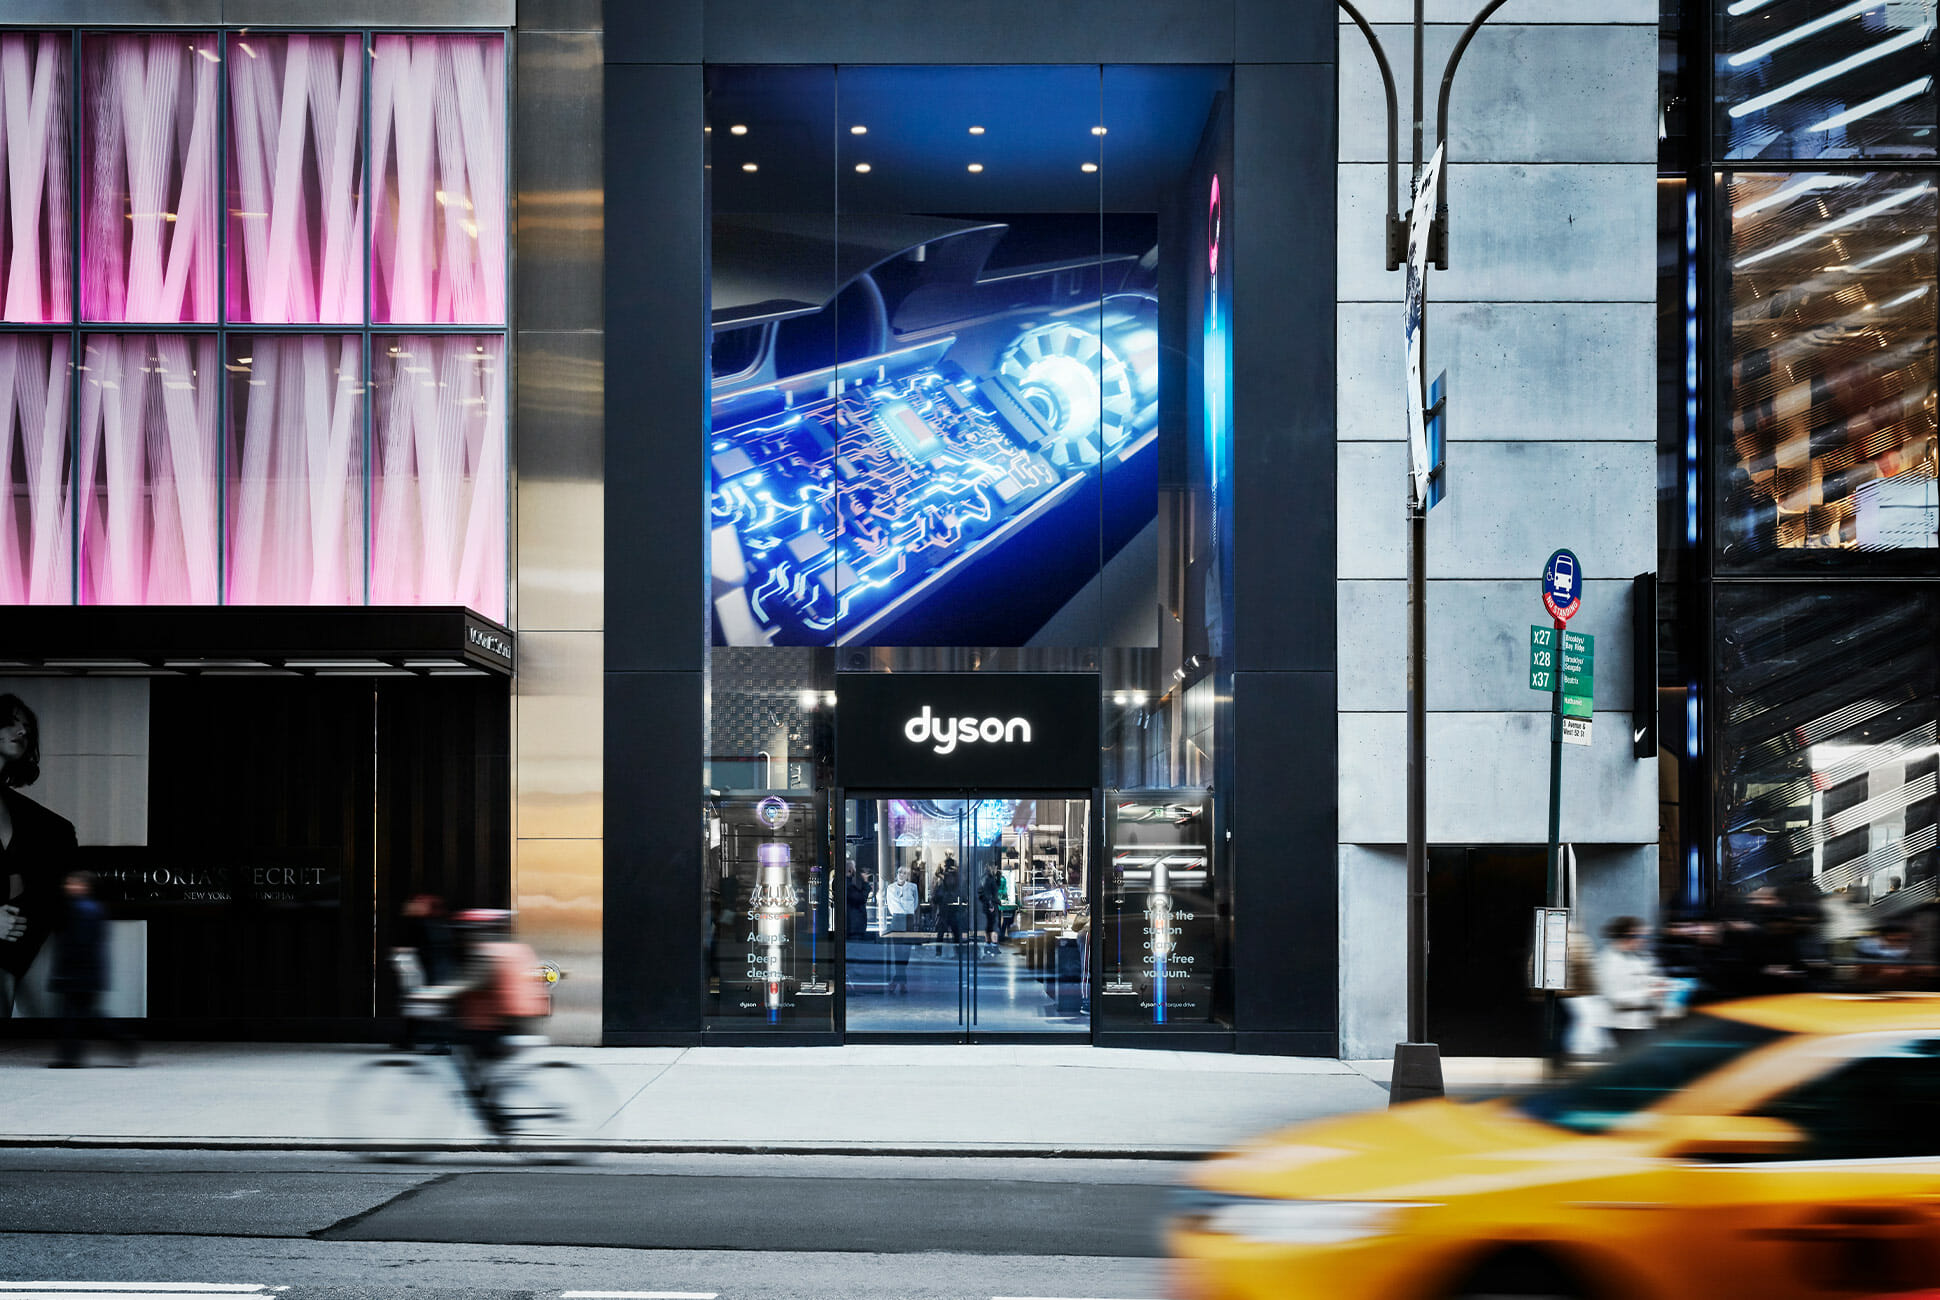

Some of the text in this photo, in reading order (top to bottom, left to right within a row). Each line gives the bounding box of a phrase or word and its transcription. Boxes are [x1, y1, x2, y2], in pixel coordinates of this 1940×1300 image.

[1547, 595, 1577, 617] NO STANDING
[905, 705, 1031, 754] dyson
[1176, 910, 1194, 921] the
[747, 954, 777, 966] Deep
